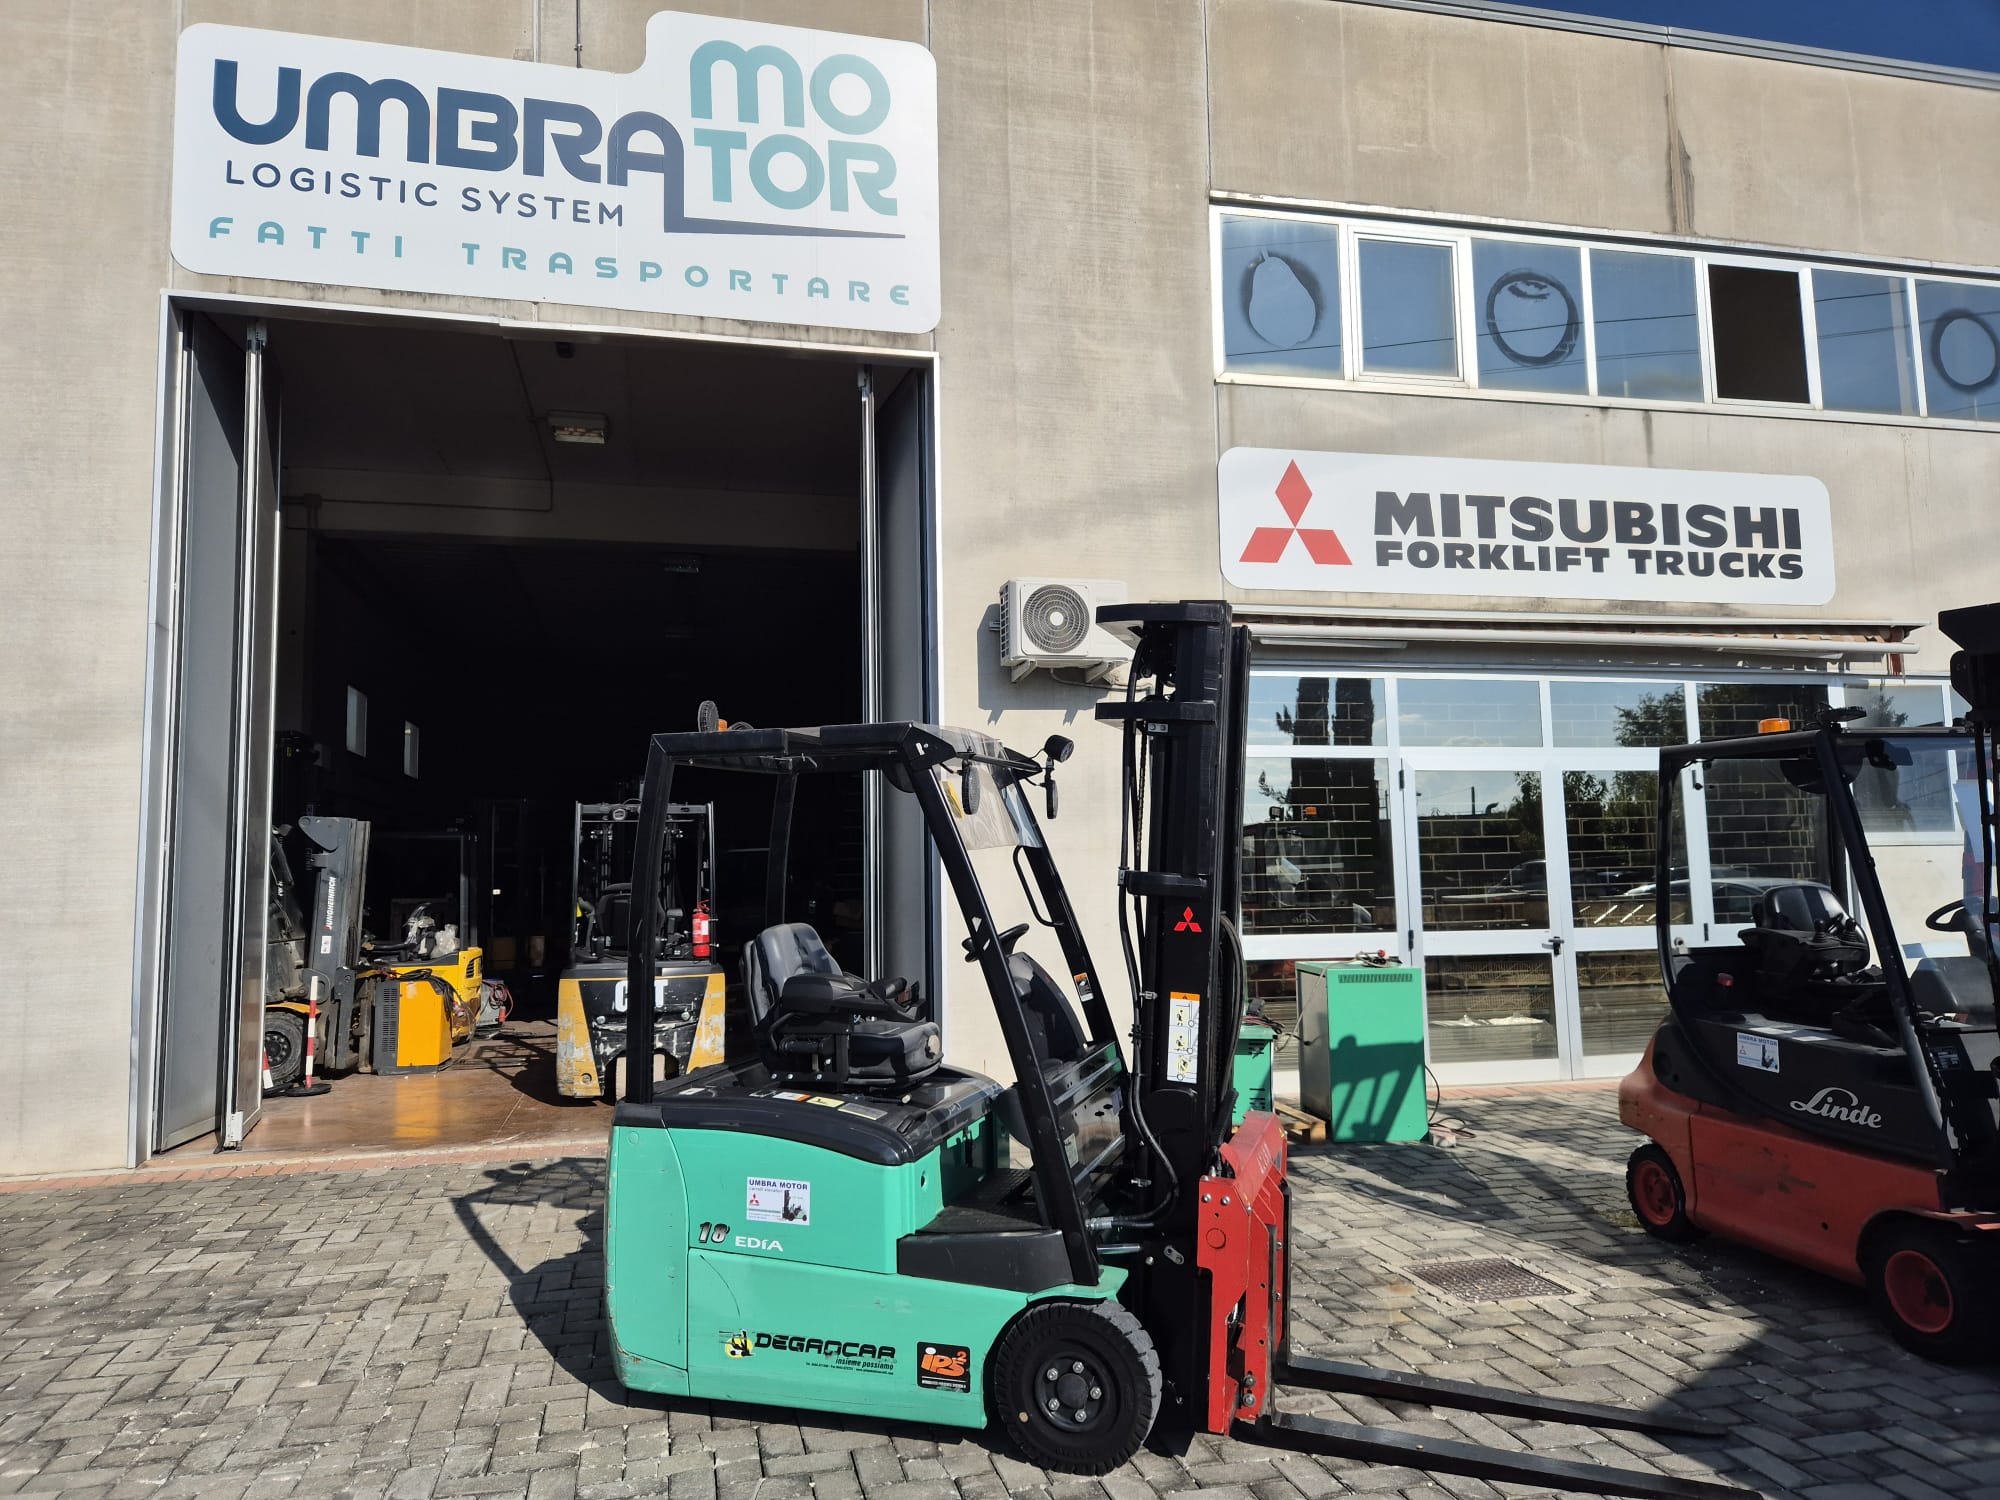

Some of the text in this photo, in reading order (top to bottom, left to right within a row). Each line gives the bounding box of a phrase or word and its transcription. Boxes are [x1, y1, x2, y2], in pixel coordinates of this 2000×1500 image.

[690, 40, 891, 135] MO
[213, 58, 686, 233] UMBRA
[694, 128, 897, 216] TOR
[226, 160, 623, 227] LOGISTIC SYSTEM
[209, 217, 909, 305] FATTI TRASPORTARE
[1375, 492, 1802, 549] MITSUBISHI
[1376, 541, 1804, 579] FORKLIFT TRUCKS
[323, 876, 337, 931] JUNGHEINRICH
[615, 980, 669, 1012] CT
[1790, 1087, 1882, 1128] Linde
[749, 1179, 808, 1190] UMBRA MOTOR
[699, 1222, 731, 1243] 18
[836, 1357, 861, 1367] insieme
[862, 1360, 894, 1370] possiamo
